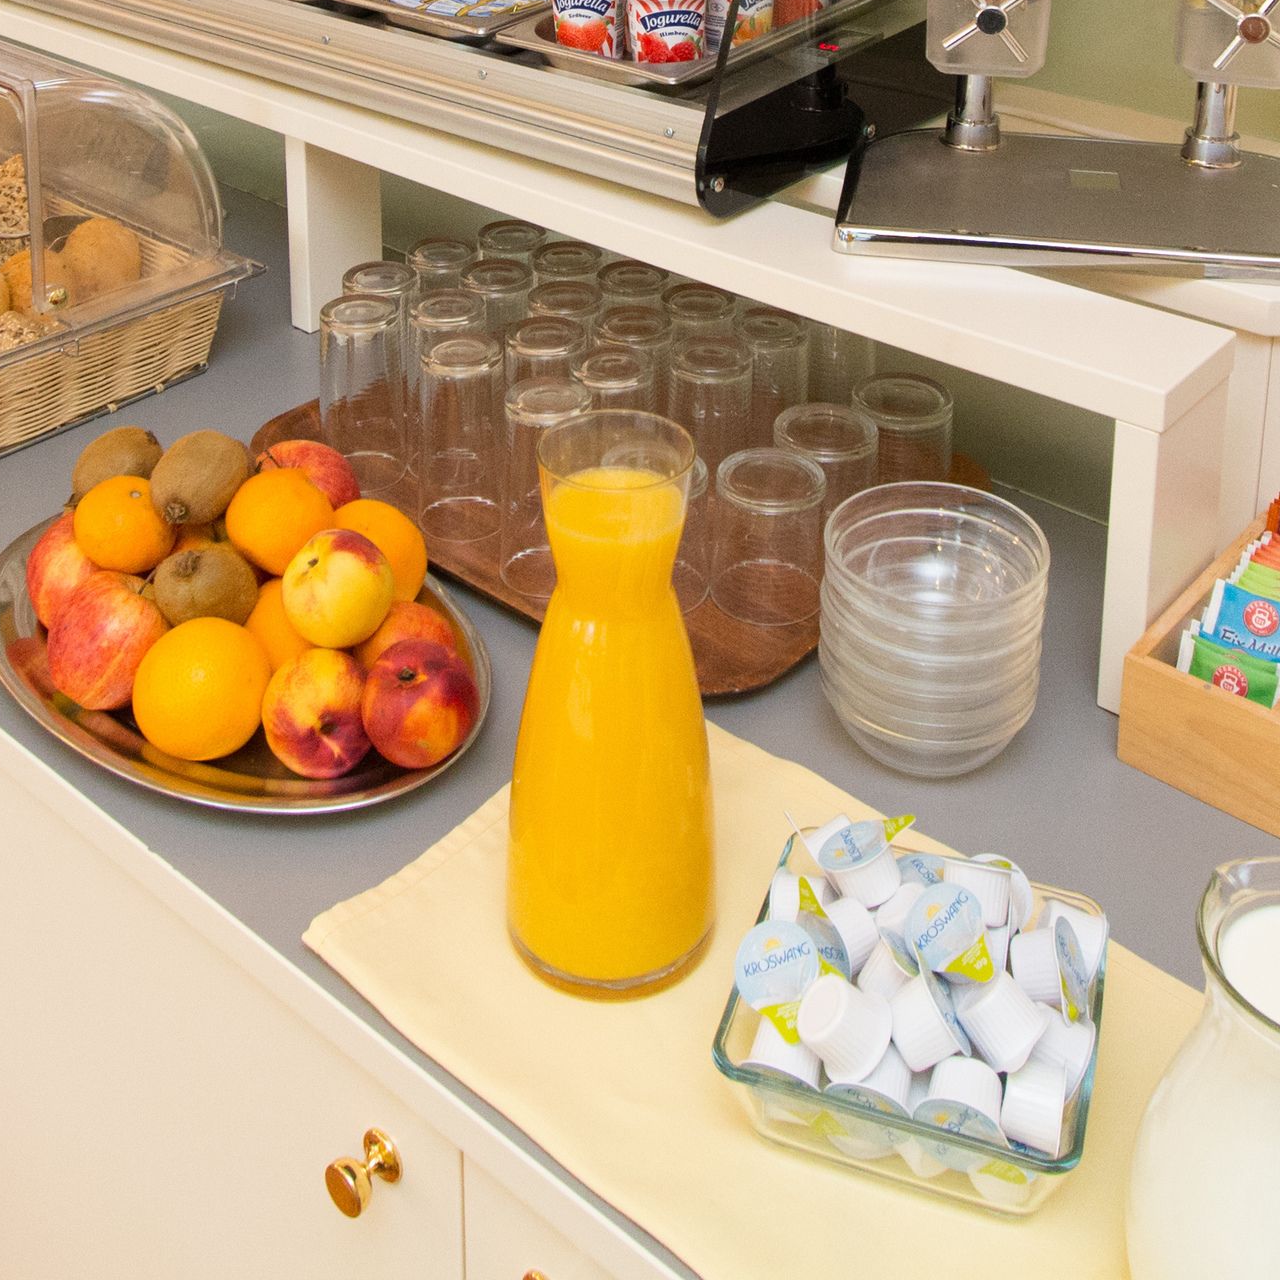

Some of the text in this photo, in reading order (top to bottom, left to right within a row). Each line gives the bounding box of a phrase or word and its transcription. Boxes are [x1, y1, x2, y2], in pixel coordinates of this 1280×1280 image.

[645, 11, 701, 31] Jogurella
[659, 30, 689, 38] Himbeer
[1245, 601, 1280, 621] TEEKANNE
[917, 890, 969, 951] KROSWANG
[743, 941, 811, 977] KROSWANG
